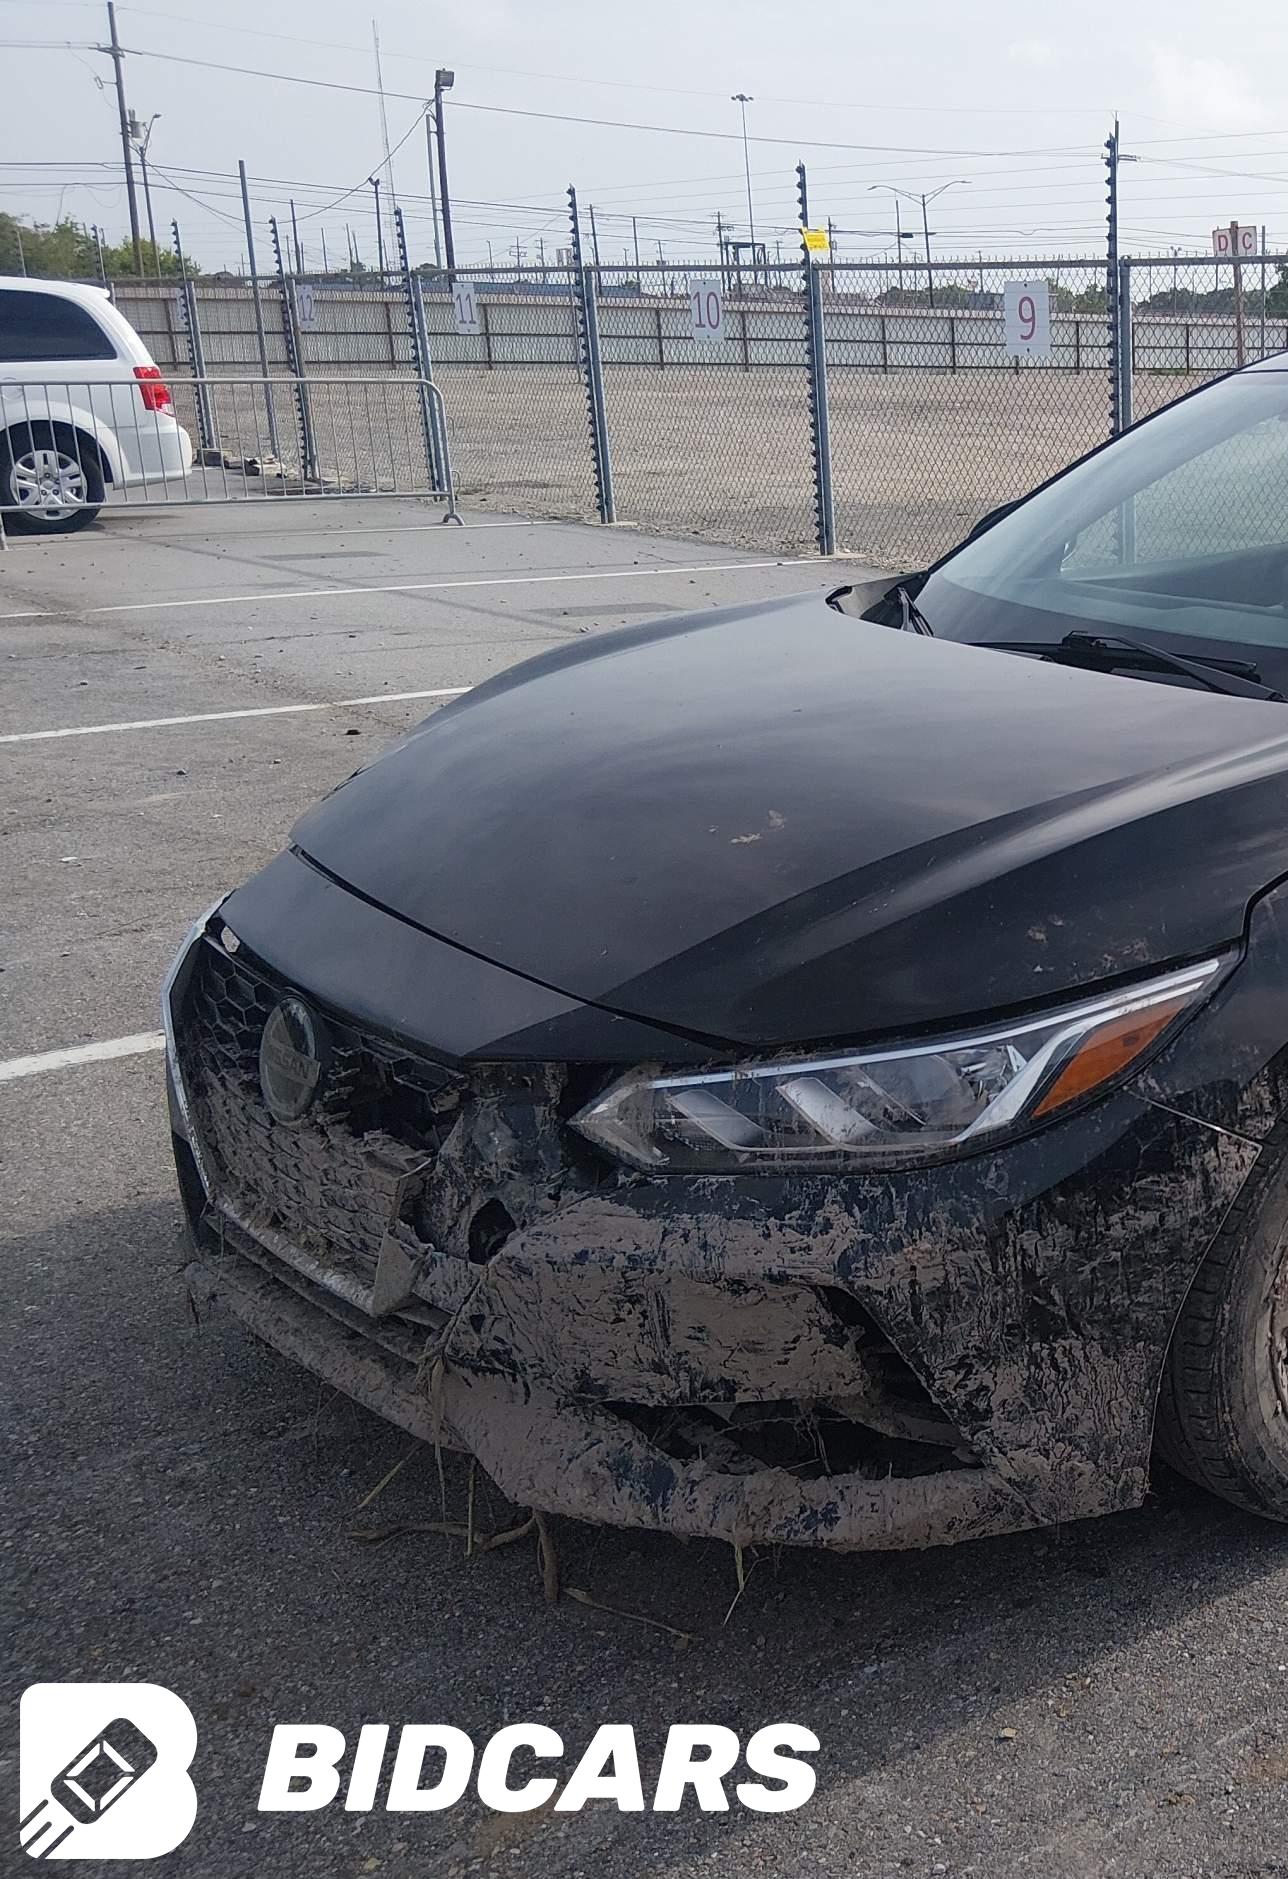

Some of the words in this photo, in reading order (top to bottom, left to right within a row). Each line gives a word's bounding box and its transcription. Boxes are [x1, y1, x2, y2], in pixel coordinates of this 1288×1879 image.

[1218, 235, 1228, 251] D
[1242, 232, 1252, 249] C
[456, 293, 476, 324] 11
[693, 291, 720, 329] 10
[1019, 296, 1035, 340] 9
